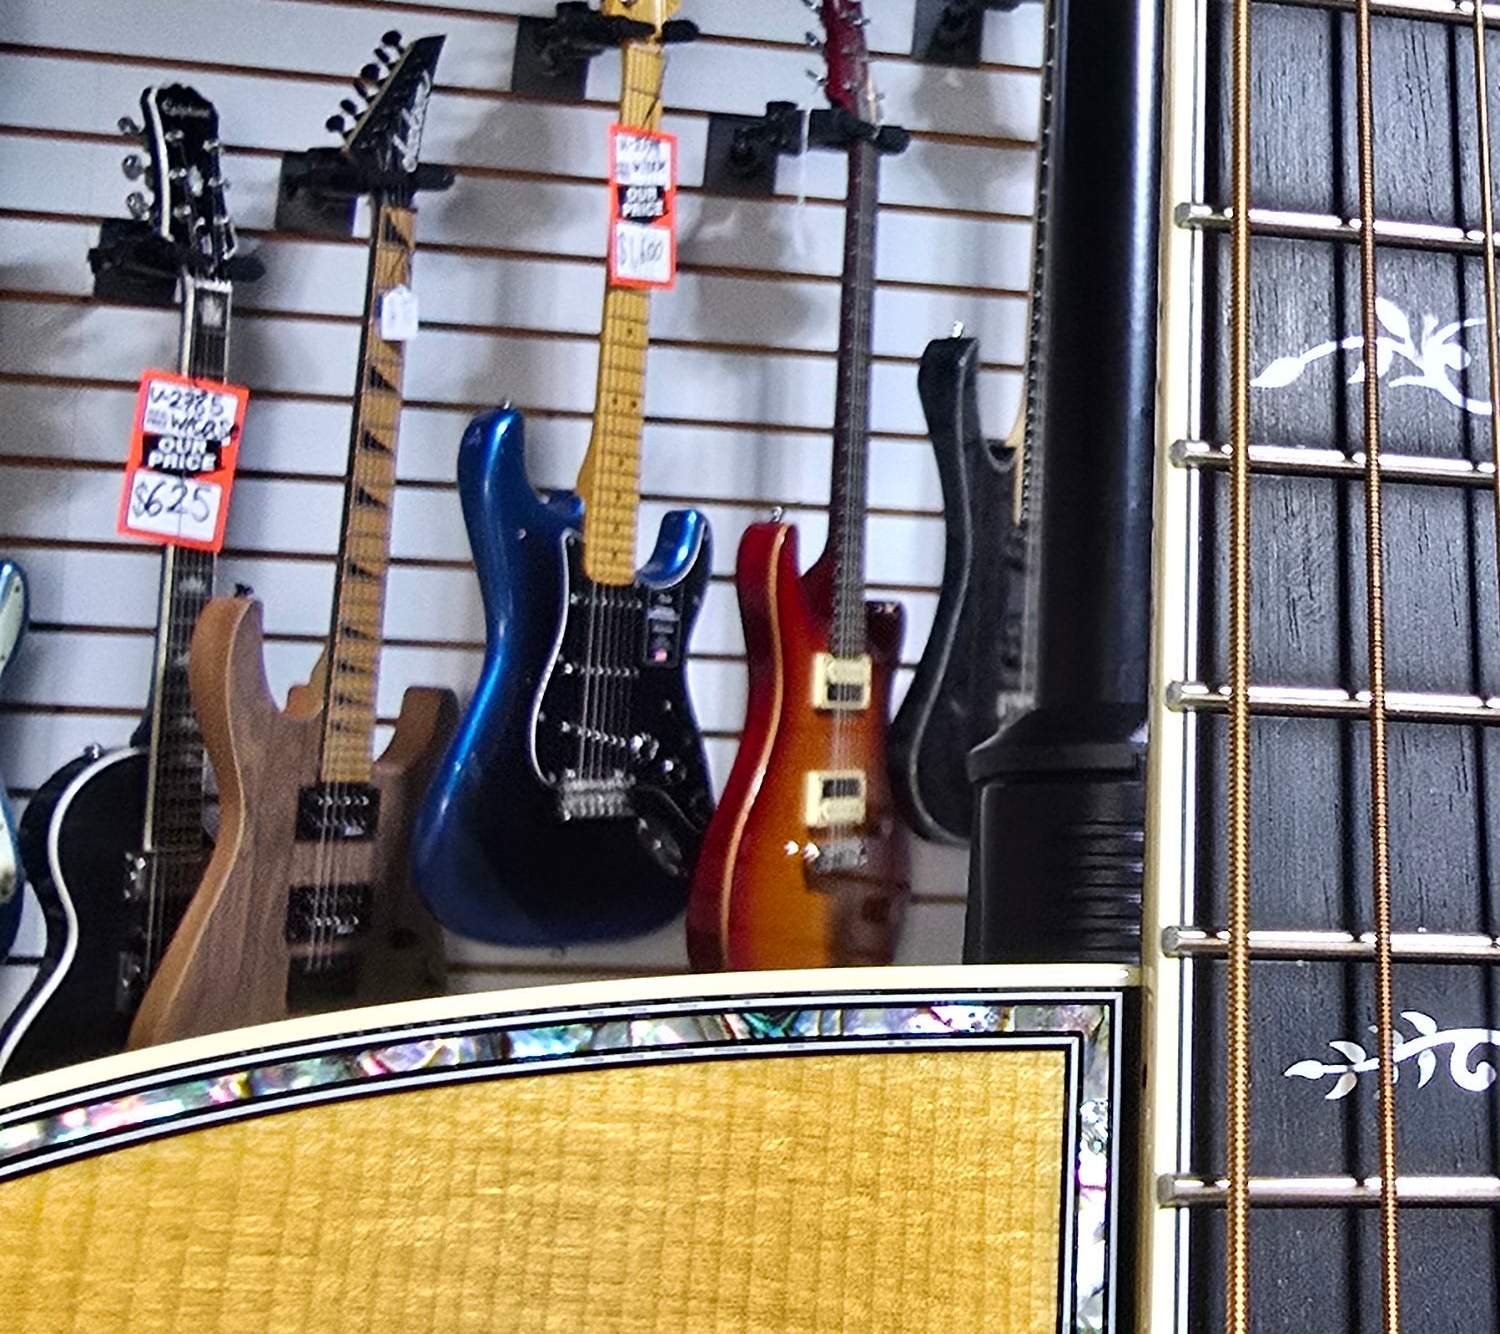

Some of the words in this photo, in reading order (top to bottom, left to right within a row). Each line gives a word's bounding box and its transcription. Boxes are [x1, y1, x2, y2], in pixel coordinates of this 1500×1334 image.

[158, 436, 208, 455] OUR
[148, 450, 218, 471] PRICE
[131, 481, 210, 523] $625
